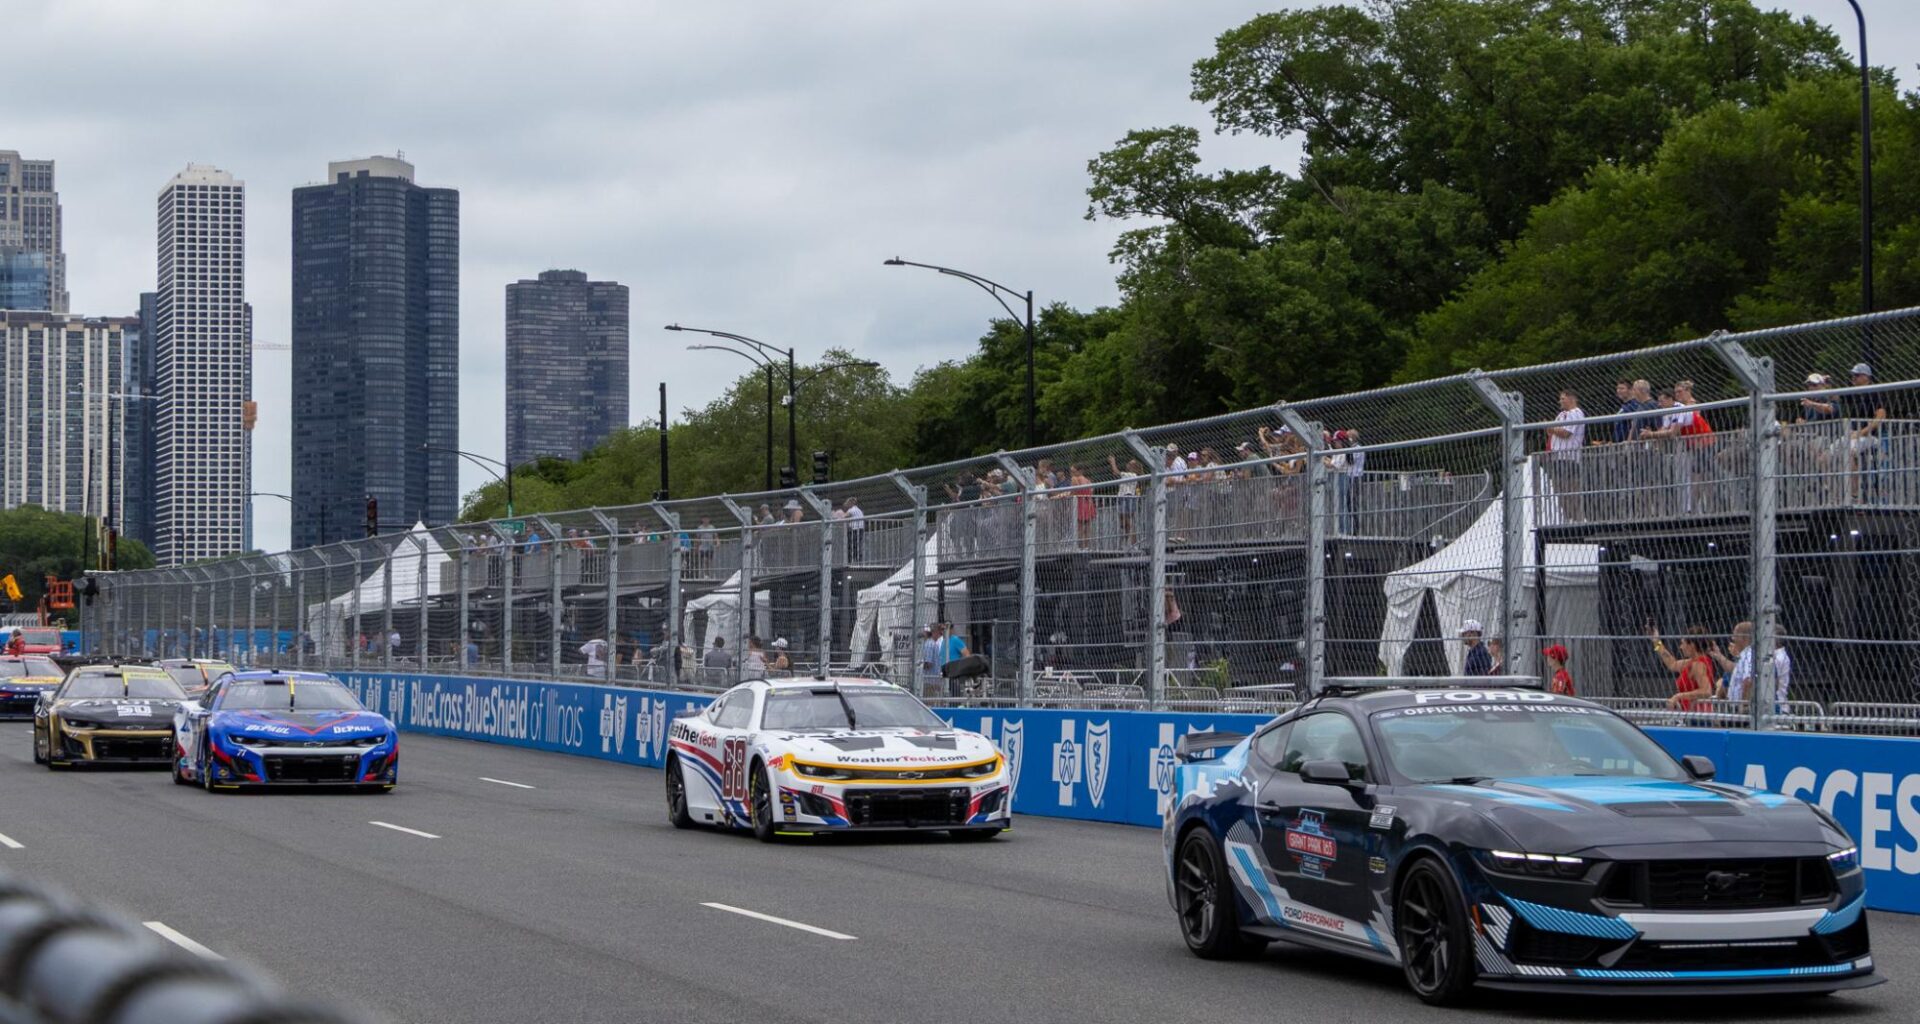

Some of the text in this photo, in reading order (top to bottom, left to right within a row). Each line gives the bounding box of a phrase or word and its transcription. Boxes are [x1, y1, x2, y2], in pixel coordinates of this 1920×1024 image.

[1415, 691, 1555, 704] FORD
[411, 679, 584, 748] BlueCross BlueShield of Illinois
[1404, 705, 1590, 716] OFFICIAL PACE VEHICLE
[837, 755, 968, 763] WeatherTech.com
[722, 736, 747, 801] 88
